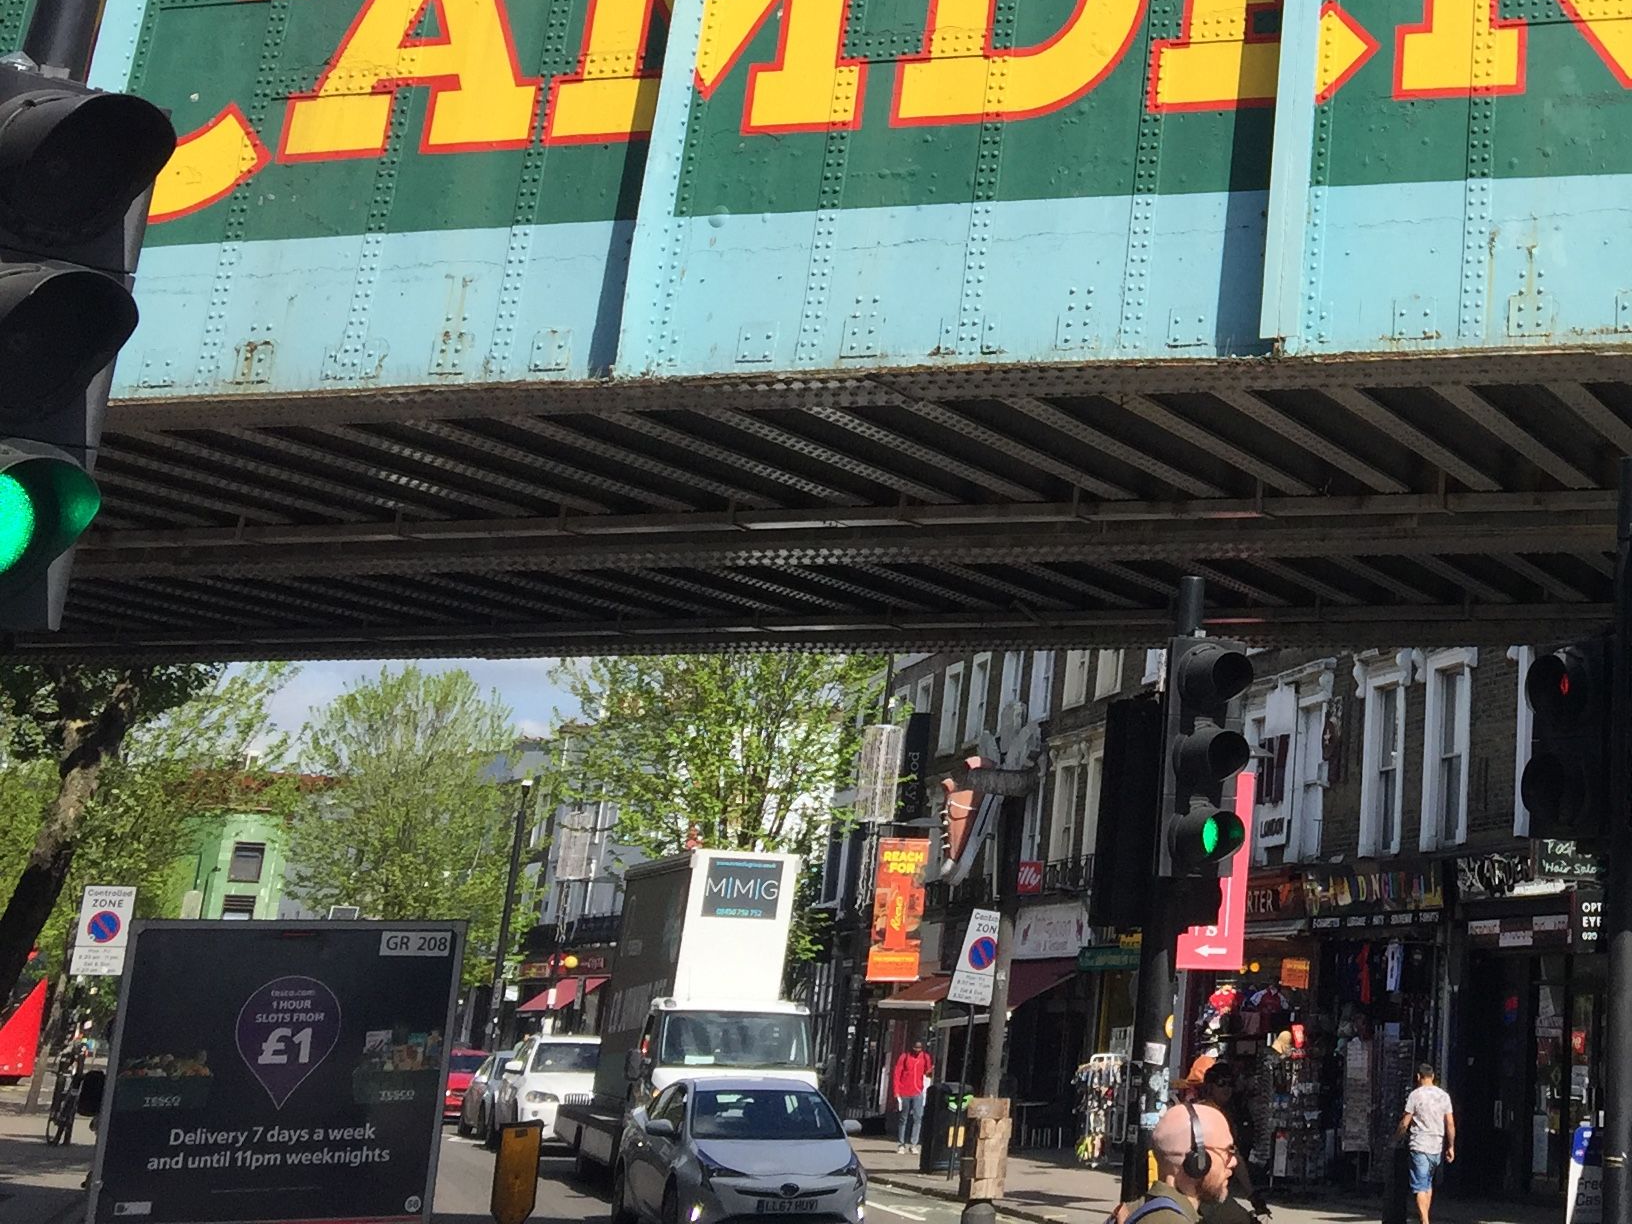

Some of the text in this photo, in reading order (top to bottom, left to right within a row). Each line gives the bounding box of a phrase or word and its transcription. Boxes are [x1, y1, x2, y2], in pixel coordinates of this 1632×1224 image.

[1260, 817, 1285, 839] LONDON
[883, 851, 924, 862] REACH
[889, 862, 916, 874] FOR
[1017, 866, 1041, 889] illy
[88, 888, 133, 897] Controlled
[91, 898, 124, 908] ZONE
[386, 935, 448, 952] GR 208
[270, 988, 316, 998] tesco.com
[279, 999, 313, 1010] HOUR
[255, 1012, 326, 1023] SLOTS FROM
[257, 1026, 313, 1065] £1
[144, 1095, 181, 1107] TESCO
[379, 1089, 416, 1101] TESCO
[168, 1123, 377, 1147] Delivery 7 days a week
[147, 1145, 391, 1170] and until 11pm weeknights
